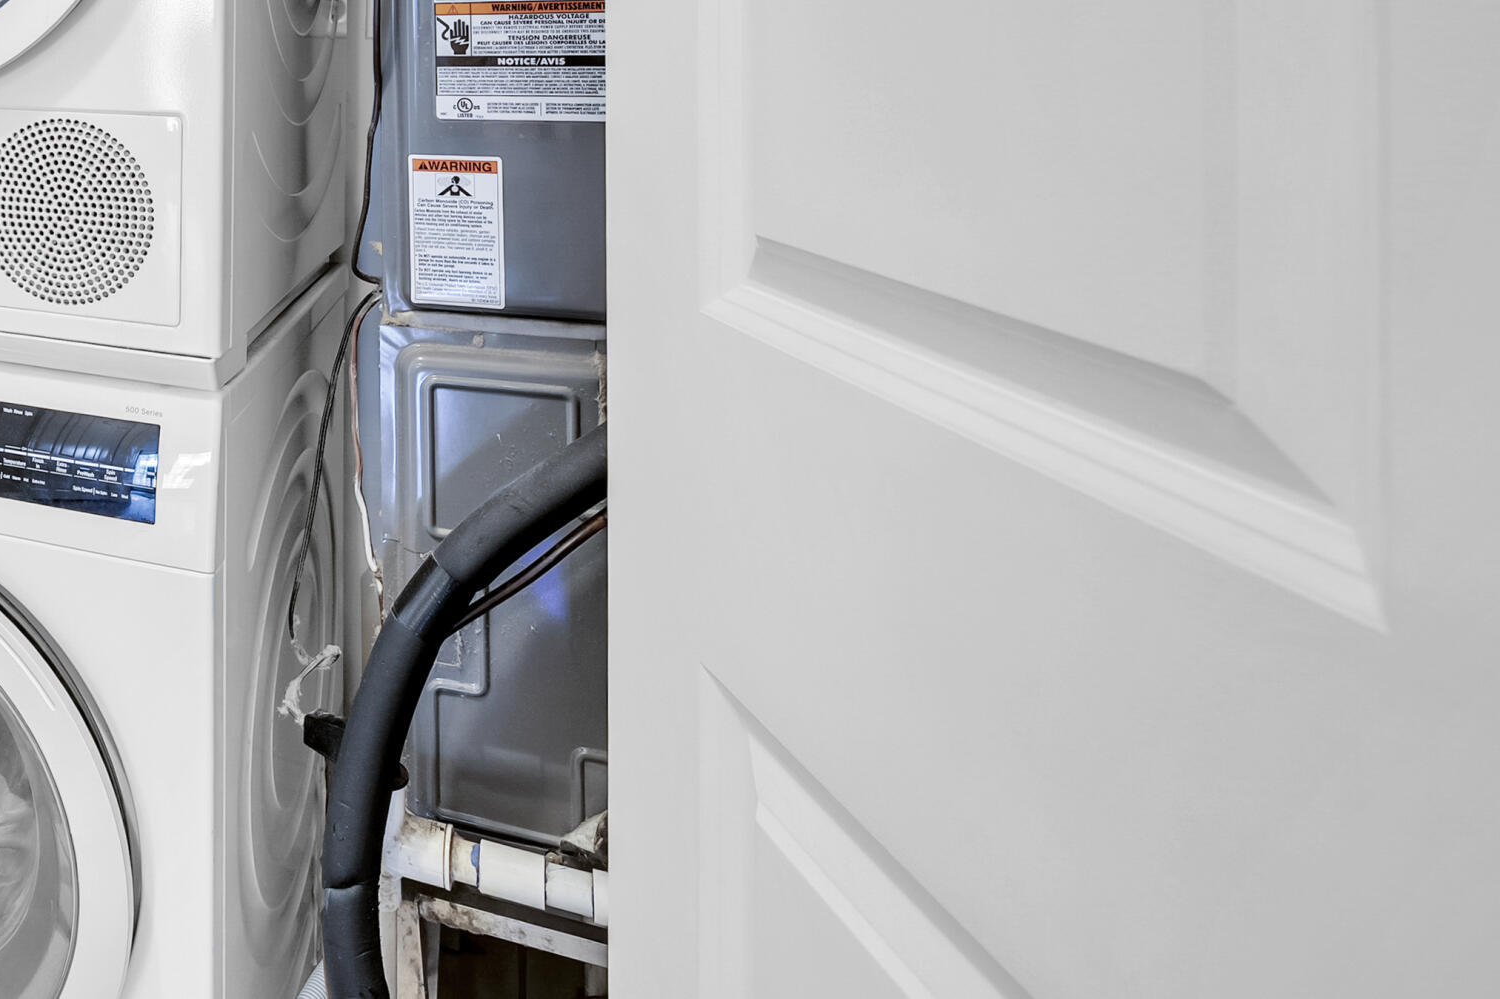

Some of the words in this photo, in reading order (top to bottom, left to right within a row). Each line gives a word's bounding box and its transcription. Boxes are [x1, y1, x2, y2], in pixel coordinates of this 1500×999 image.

[497, 57, 566, 66] NOTICE/AVIS
[460, 101, 469, 110] UL
[428, 161, 492, 173] WARNING
[125, 406, 139, 414] 500
[141, 407, 163, 418] Series
